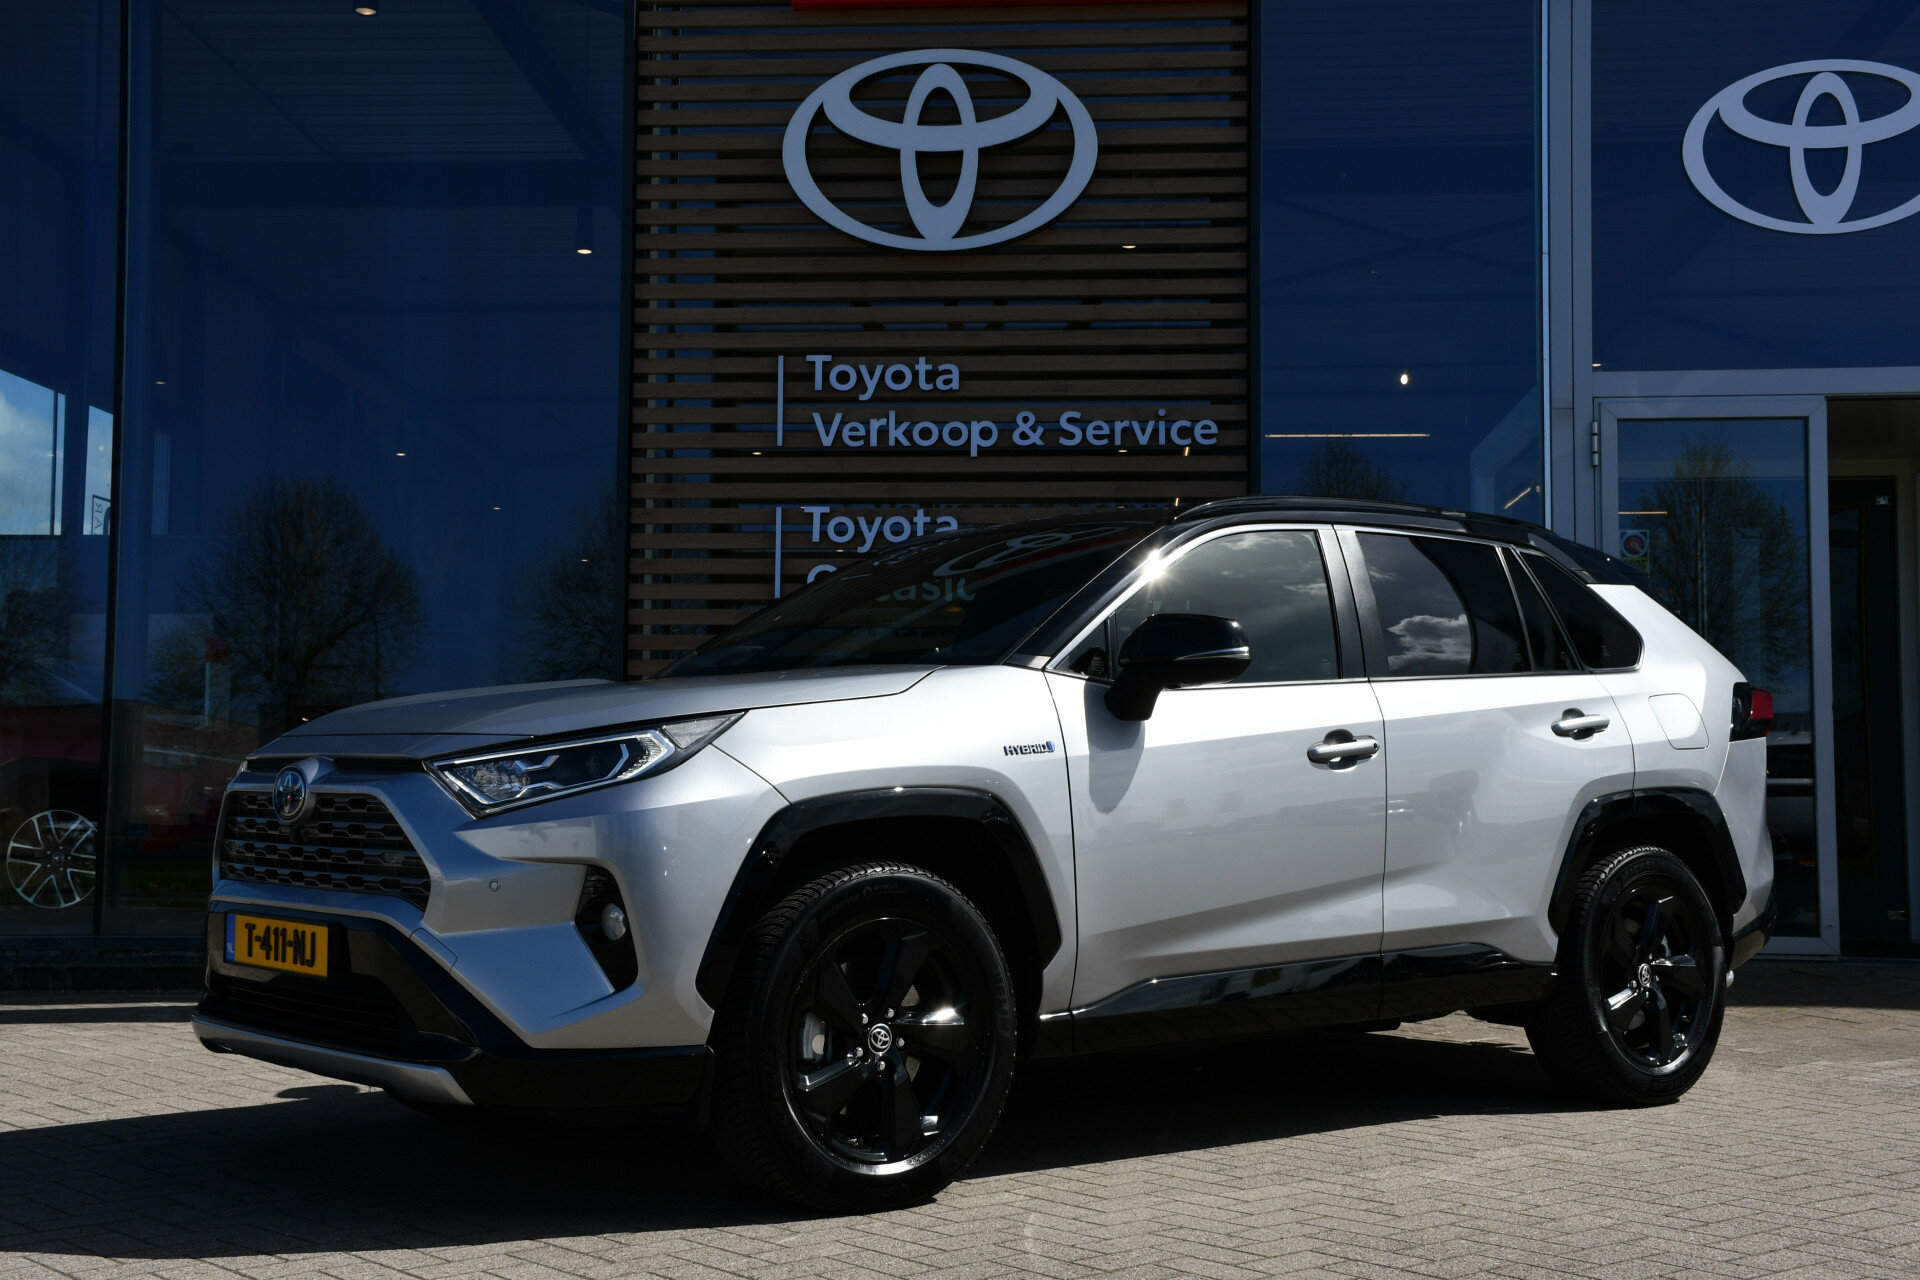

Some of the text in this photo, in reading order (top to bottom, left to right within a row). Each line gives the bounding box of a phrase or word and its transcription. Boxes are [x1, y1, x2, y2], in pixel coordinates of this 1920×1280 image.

[805, 354, 960, 401] Toyota
[812, 408, 1219, 458] Verkoop & Service
[803, 506, 958, 554] Toyota
[1003, 742, 1051, 756] HYBRID
[227, 941, 234, 954] NL
[245, 923, 316, 968] T-411-NJ
